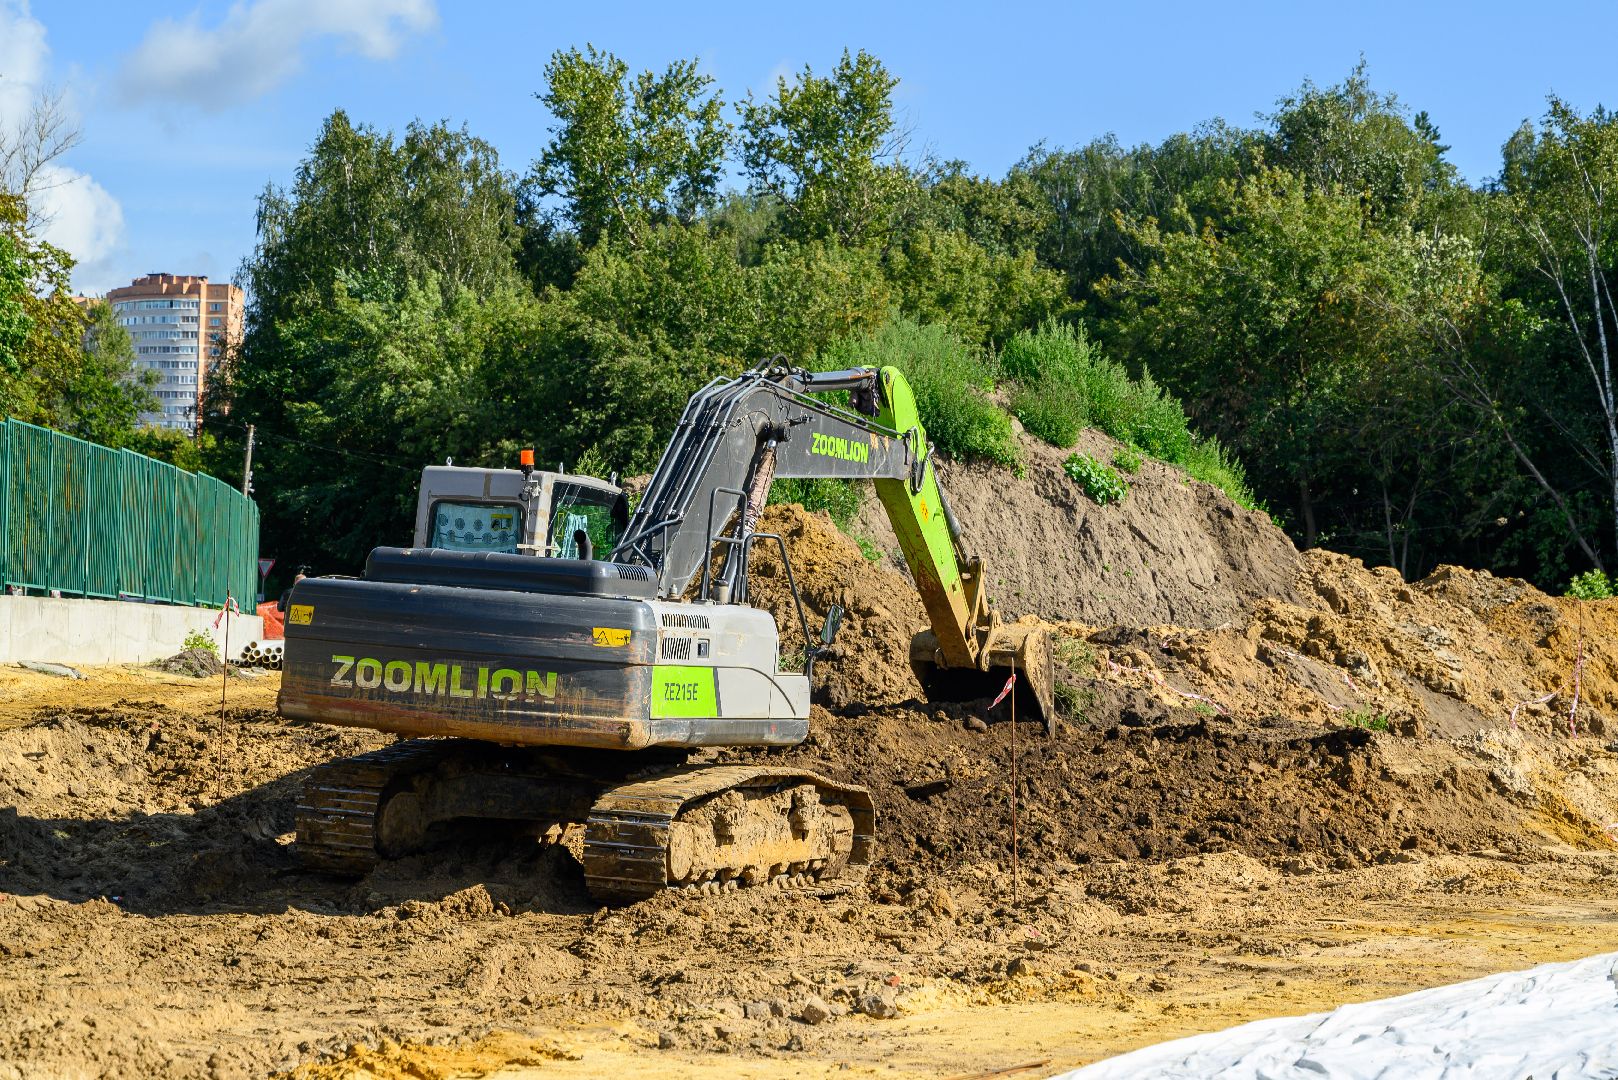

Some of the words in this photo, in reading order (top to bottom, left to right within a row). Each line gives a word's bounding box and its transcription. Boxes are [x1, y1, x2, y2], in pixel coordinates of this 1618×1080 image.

[811, 432, 869, 464] ZOOMLION
[330, 654, 558, 704] ZOOMLION
[664, 682, 699, 701] ZE215E
